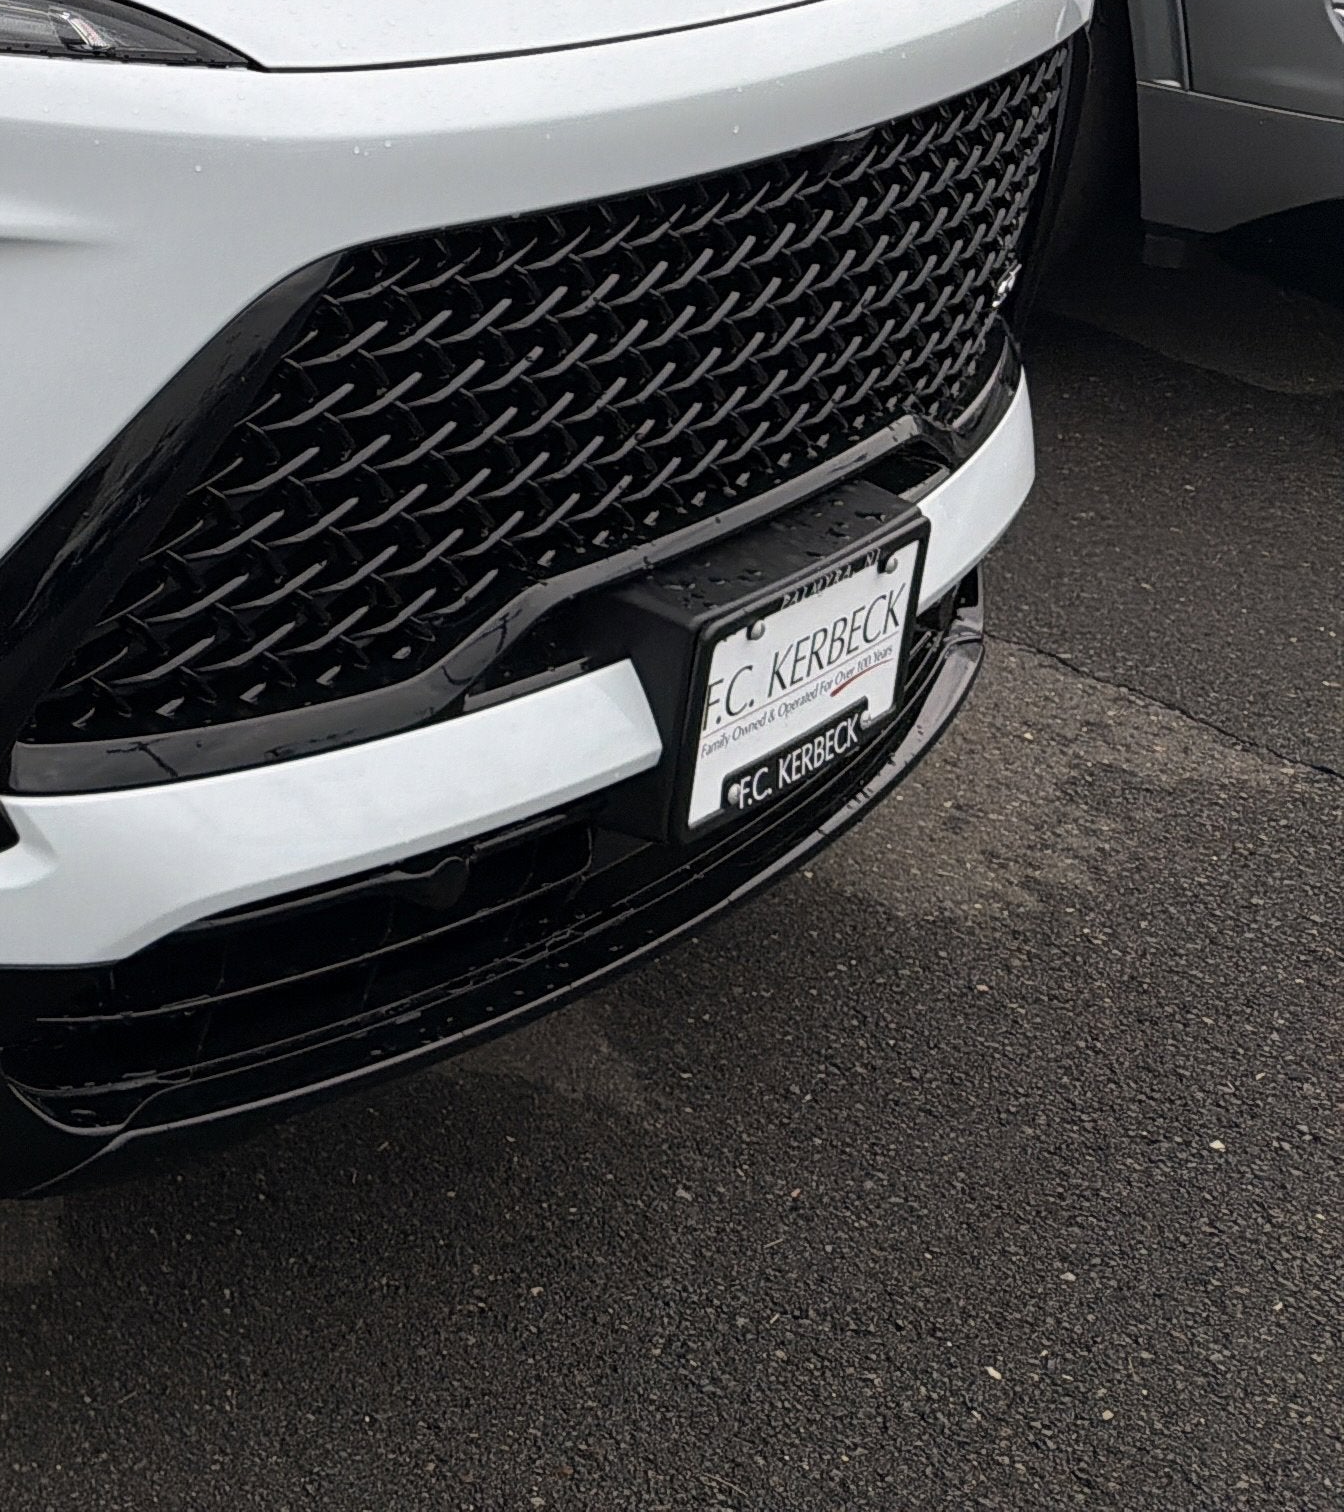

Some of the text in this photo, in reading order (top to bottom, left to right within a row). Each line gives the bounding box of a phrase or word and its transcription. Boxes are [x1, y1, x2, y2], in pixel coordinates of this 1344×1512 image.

[700, 730, 731, 759] Family
[732, 714, 769, 742] Owned
[777, 686, 819, 719] Operated
[820, 679, 834, 699] For
[834, 668, 856, 689] Over
[872, 644, 893, 665] Years
[703, 582, 907, 731] F.C. KERBECK
[739, 713, 860, 810] F.C. KERBECK
